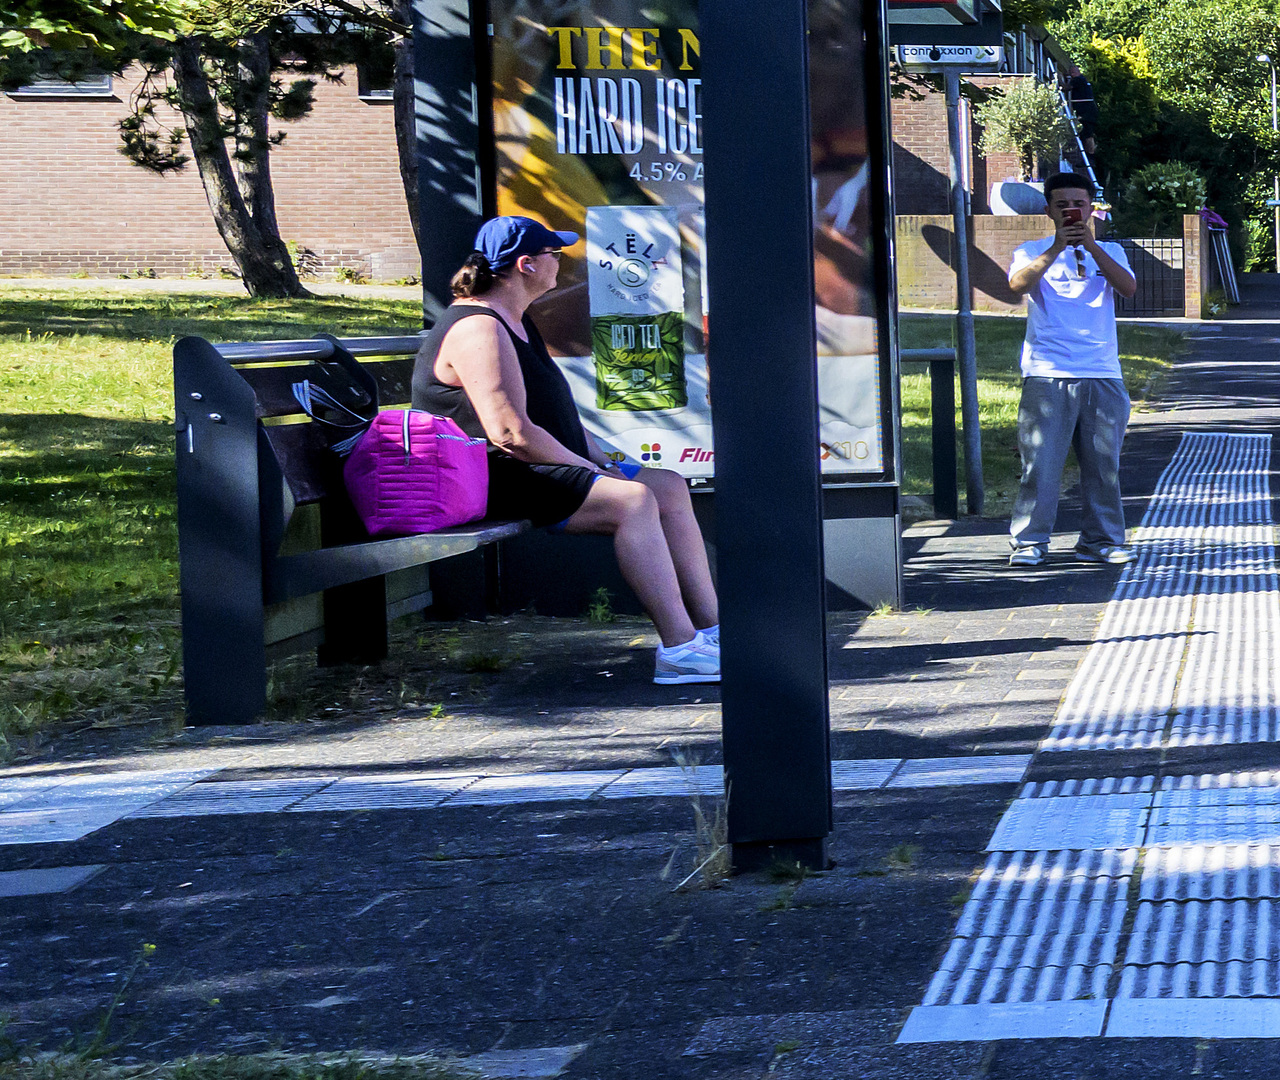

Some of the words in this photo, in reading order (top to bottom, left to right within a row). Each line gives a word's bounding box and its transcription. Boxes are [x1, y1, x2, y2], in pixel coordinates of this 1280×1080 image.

[548, 27, 661, 70] THE
[903, 48, 972, 56] connxxion
[555, 77, 644, 154] HARD
[629, 162, 686, 181] 4.5%
[611, 324, 636, 349] ICED
[639, 324, 662, 349] TEA
